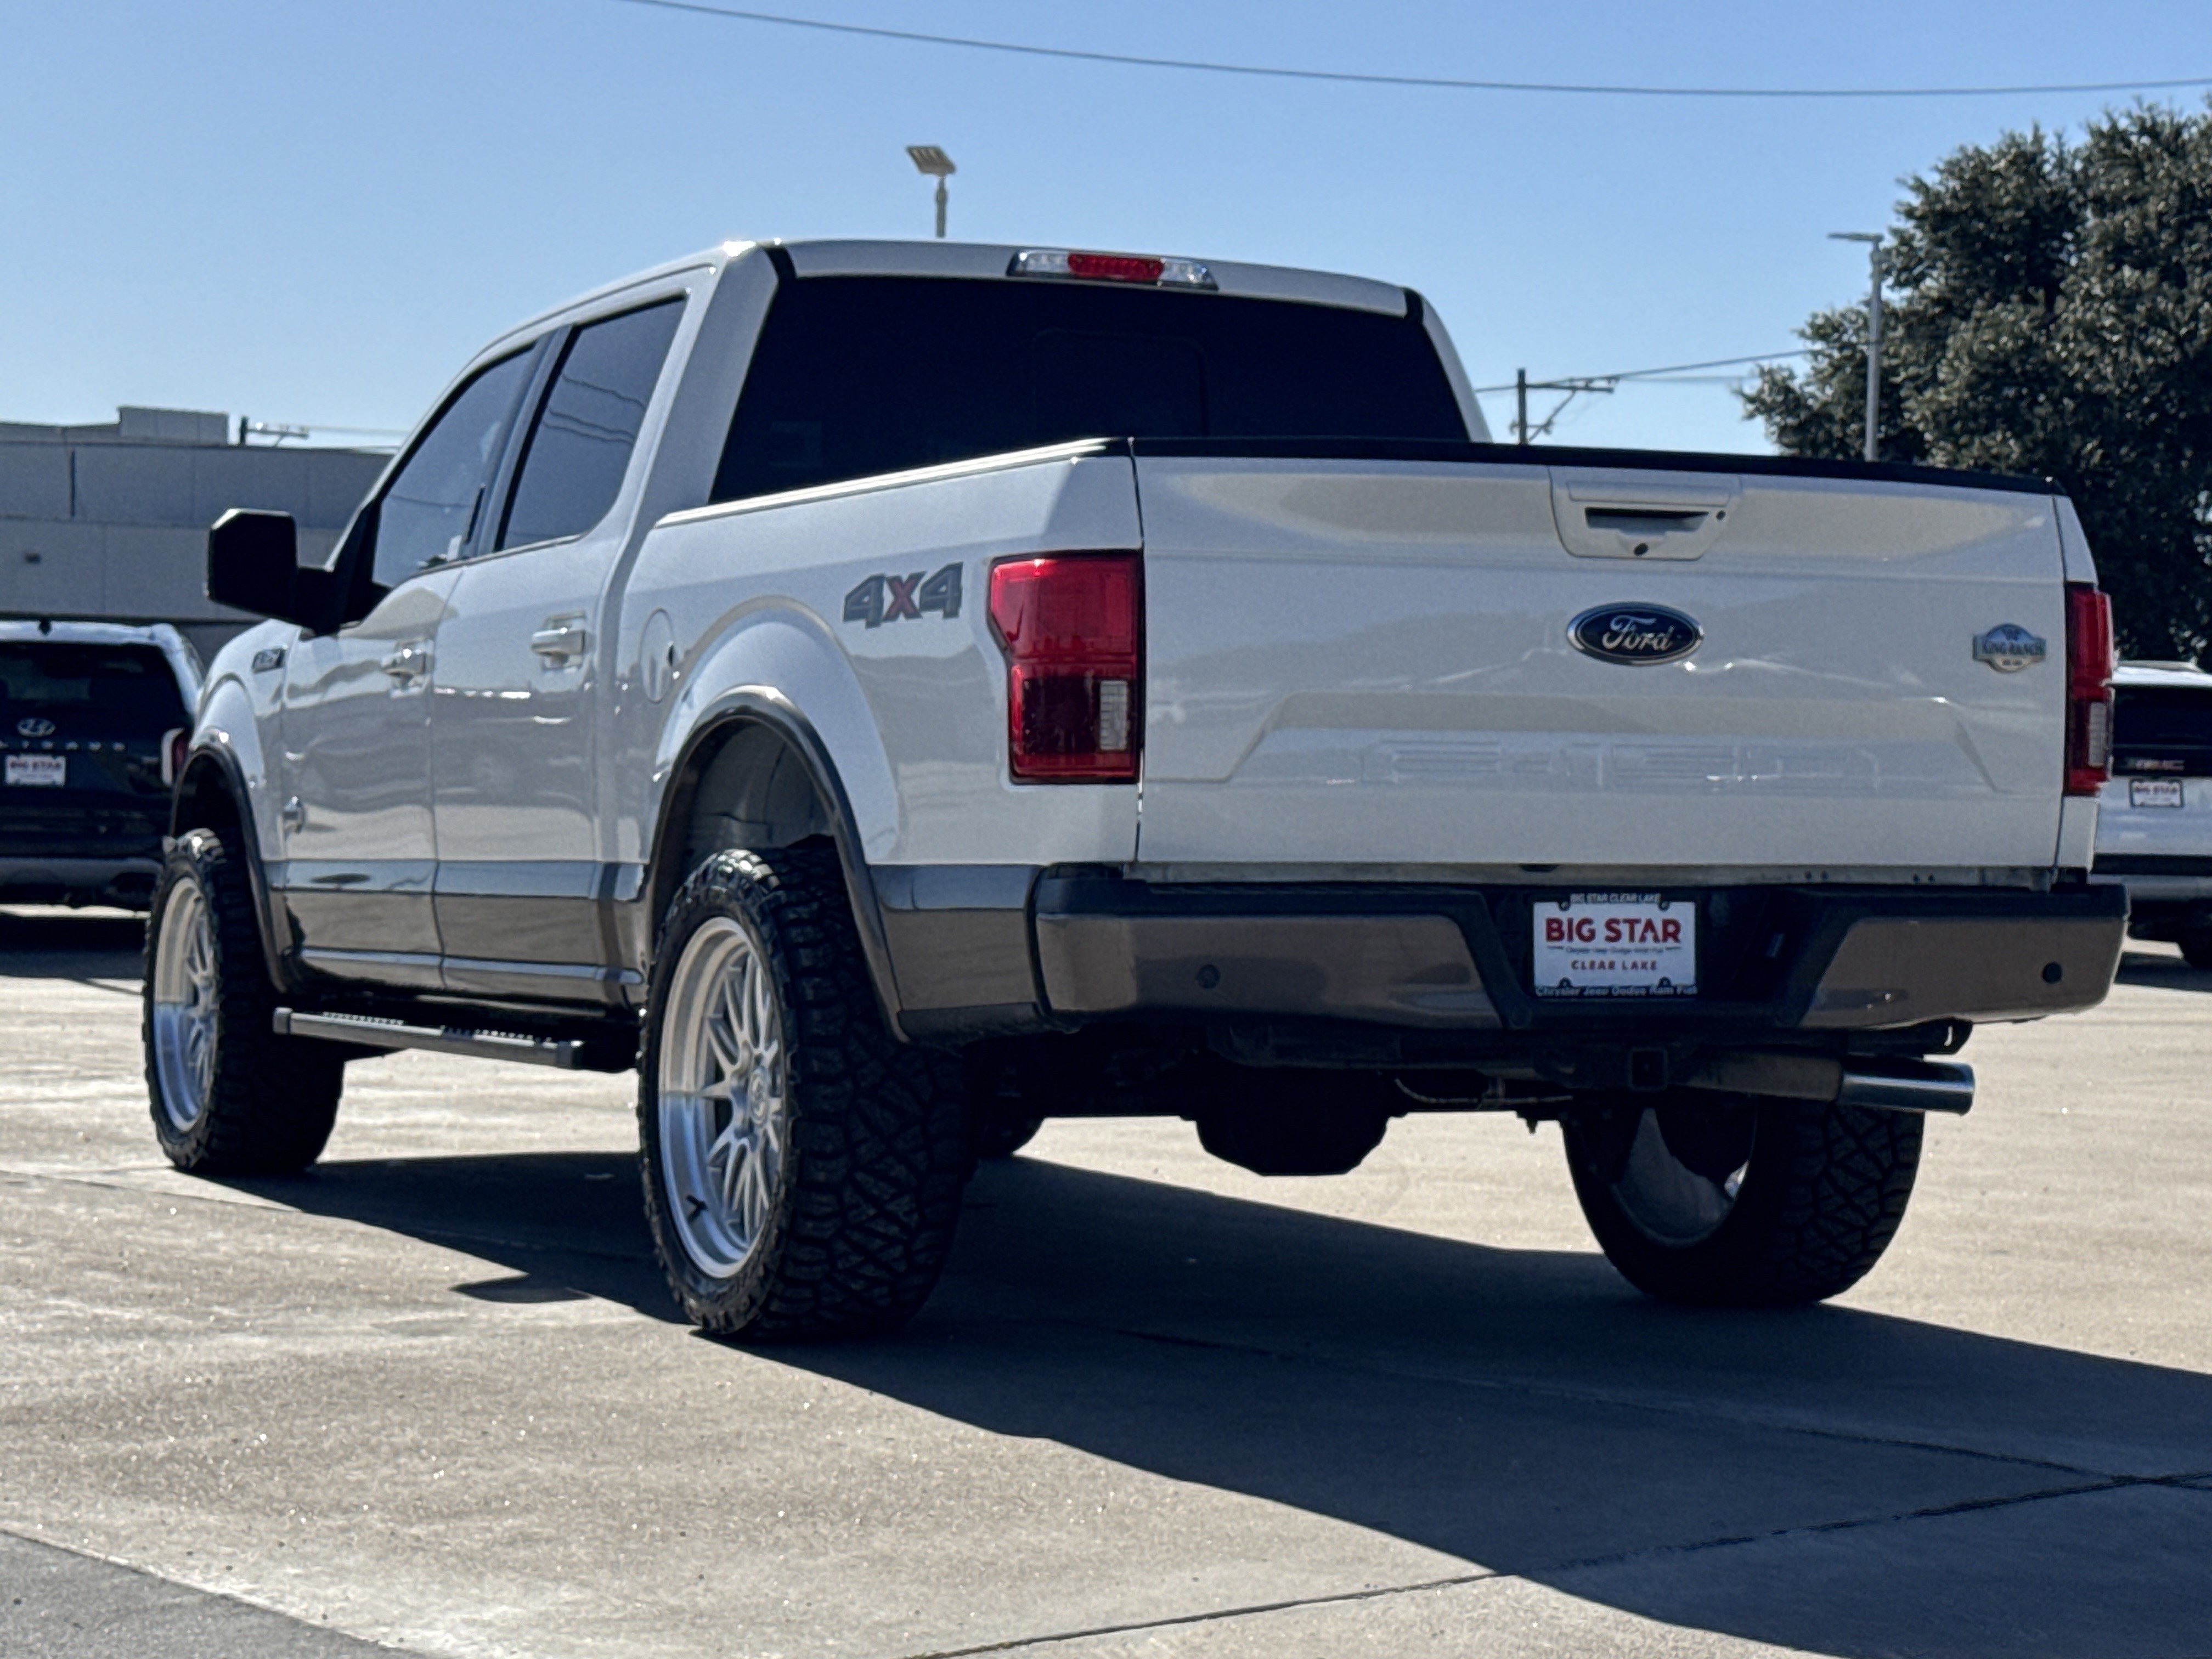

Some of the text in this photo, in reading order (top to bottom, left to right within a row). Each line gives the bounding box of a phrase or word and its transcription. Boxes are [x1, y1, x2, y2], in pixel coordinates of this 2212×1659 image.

[1601, 614, 1675, 651] Ford
[1545, 917, 1682, 944] BIG STAR
[1571, 960, 1657, 971] CLEAR LAKE
